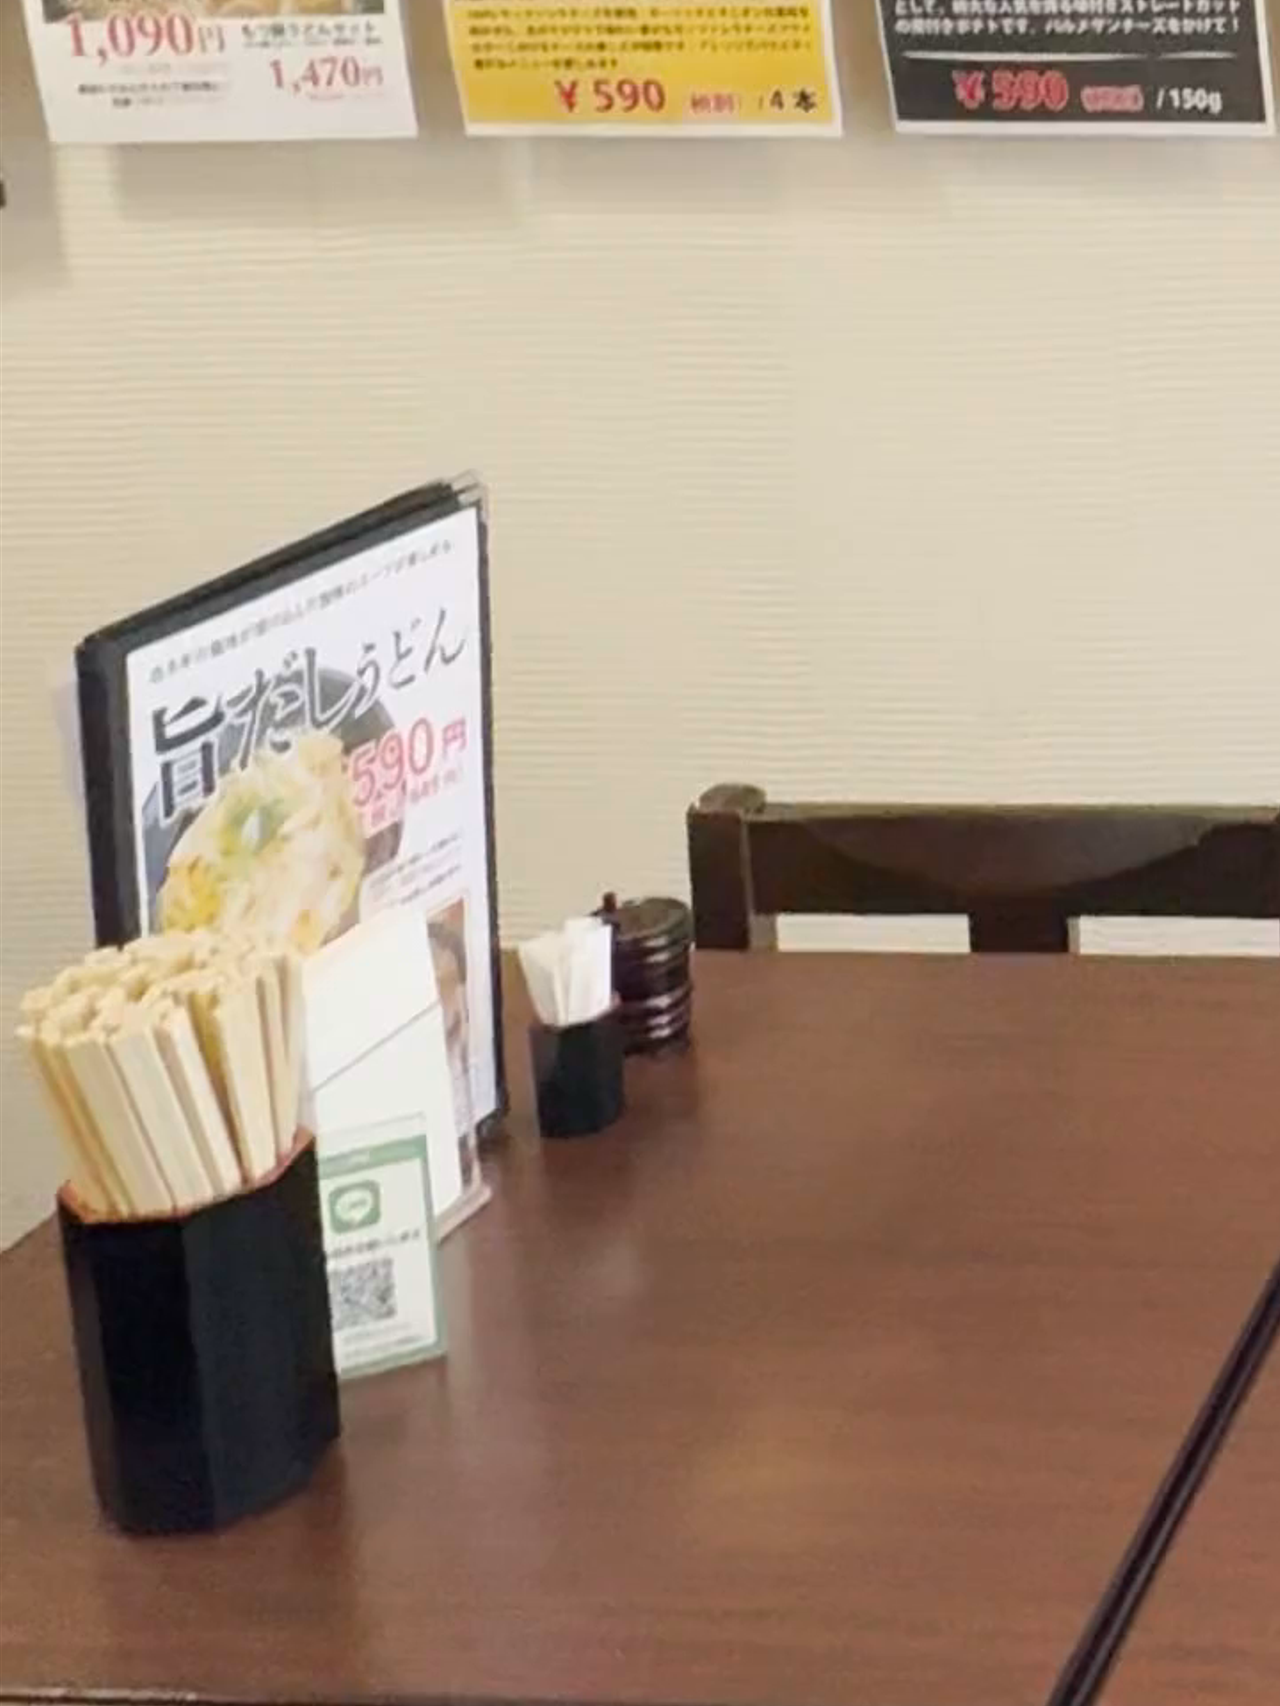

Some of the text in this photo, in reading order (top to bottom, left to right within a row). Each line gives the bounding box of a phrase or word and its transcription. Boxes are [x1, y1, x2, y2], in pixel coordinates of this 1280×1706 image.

[65, 10, 226, 66] 1,090円
[268, 55, 384, 92] 1,470円
[150, 606, 466, 820] 旨だしうどん
[350, 714, 469, 808] 590円
